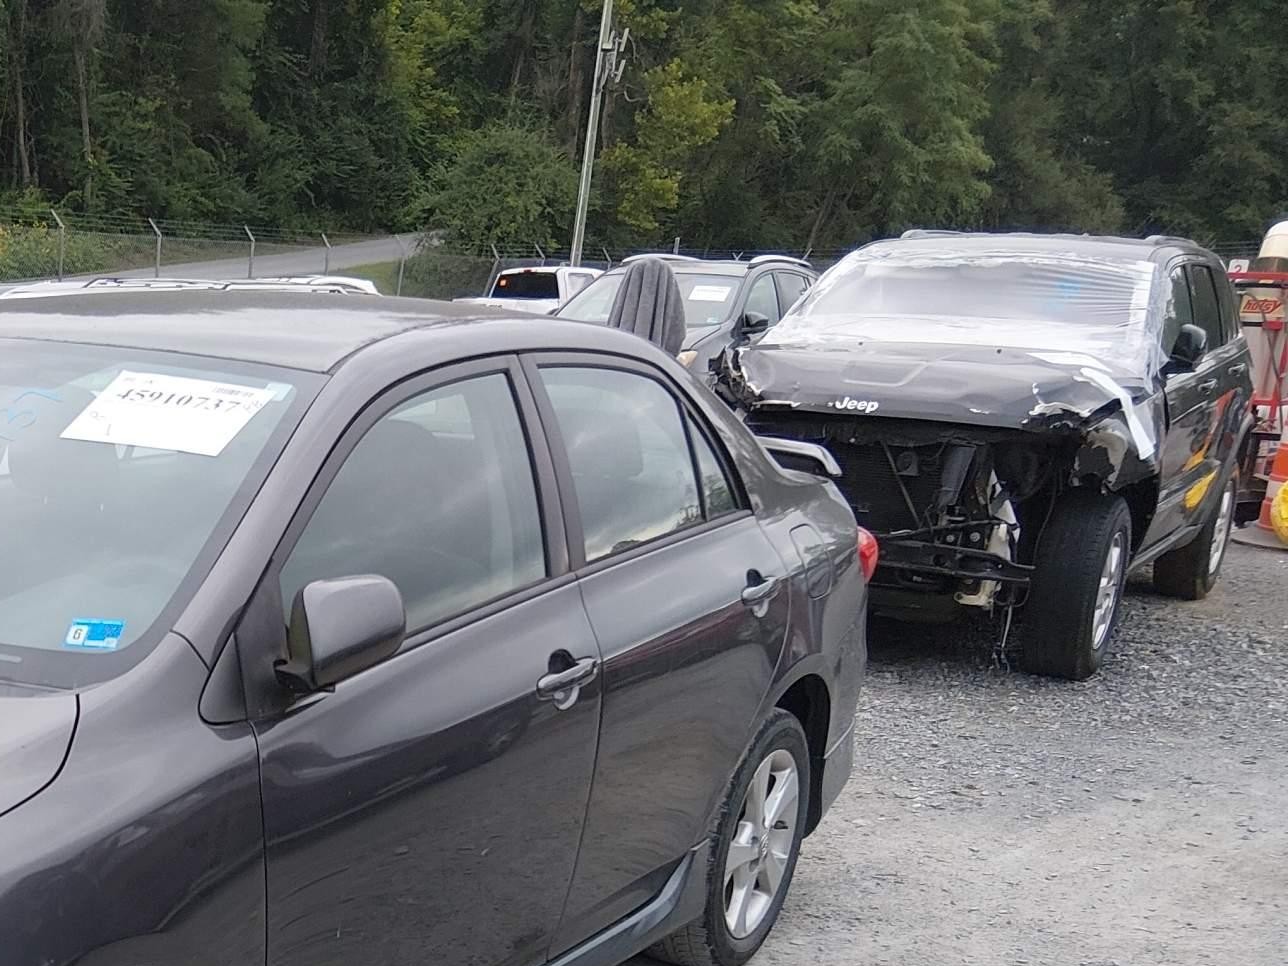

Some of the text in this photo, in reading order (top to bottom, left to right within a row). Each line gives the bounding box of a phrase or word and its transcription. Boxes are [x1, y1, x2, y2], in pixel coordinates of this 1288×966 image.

[116, 388, 241, 413] 45910737
[835, 396, 879, 414] Jeep
[73, 628, 83, 640] 6
